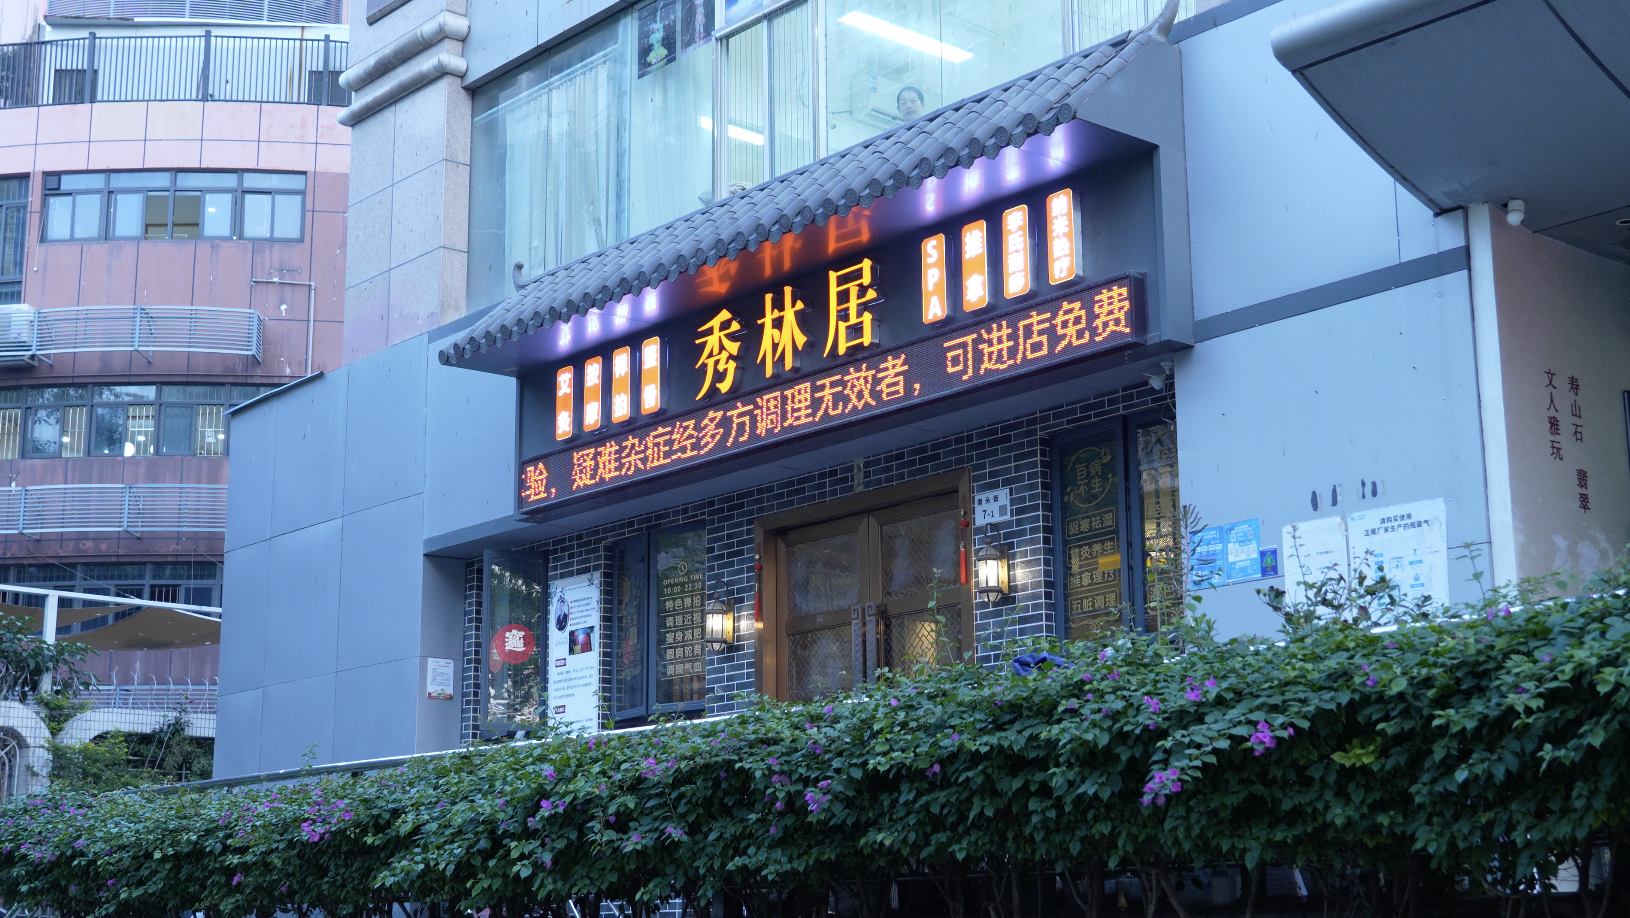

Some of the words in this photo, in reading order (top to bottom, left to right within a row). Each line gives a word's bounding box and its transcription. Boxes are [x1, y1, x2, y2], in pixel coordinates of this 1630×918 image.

[926, 239, 942, 320] SPA
[694, 257, 878, 401] 秀林居
[1544, 368, 1563, 461] 文人雅玩
[1567, 375, 1584, 444] 寿山石
[1075, 459, 1102, 480] 百病
[982, 509, 995, 520] 7-1
[1068, 512, 1114, 536] 驱寒祛湿
[1379, 512, 1412, 526] 请购买使用
[1364, 518, 1430, 537] 正规厂家生产的瓶装气
[662, 576, 688, 586] OPENING
[1071, 592, 1117, 614] 五脏调理
[665, 612, 702, 628] 调理近视
[666, 661, 703, 677] 调理气血
